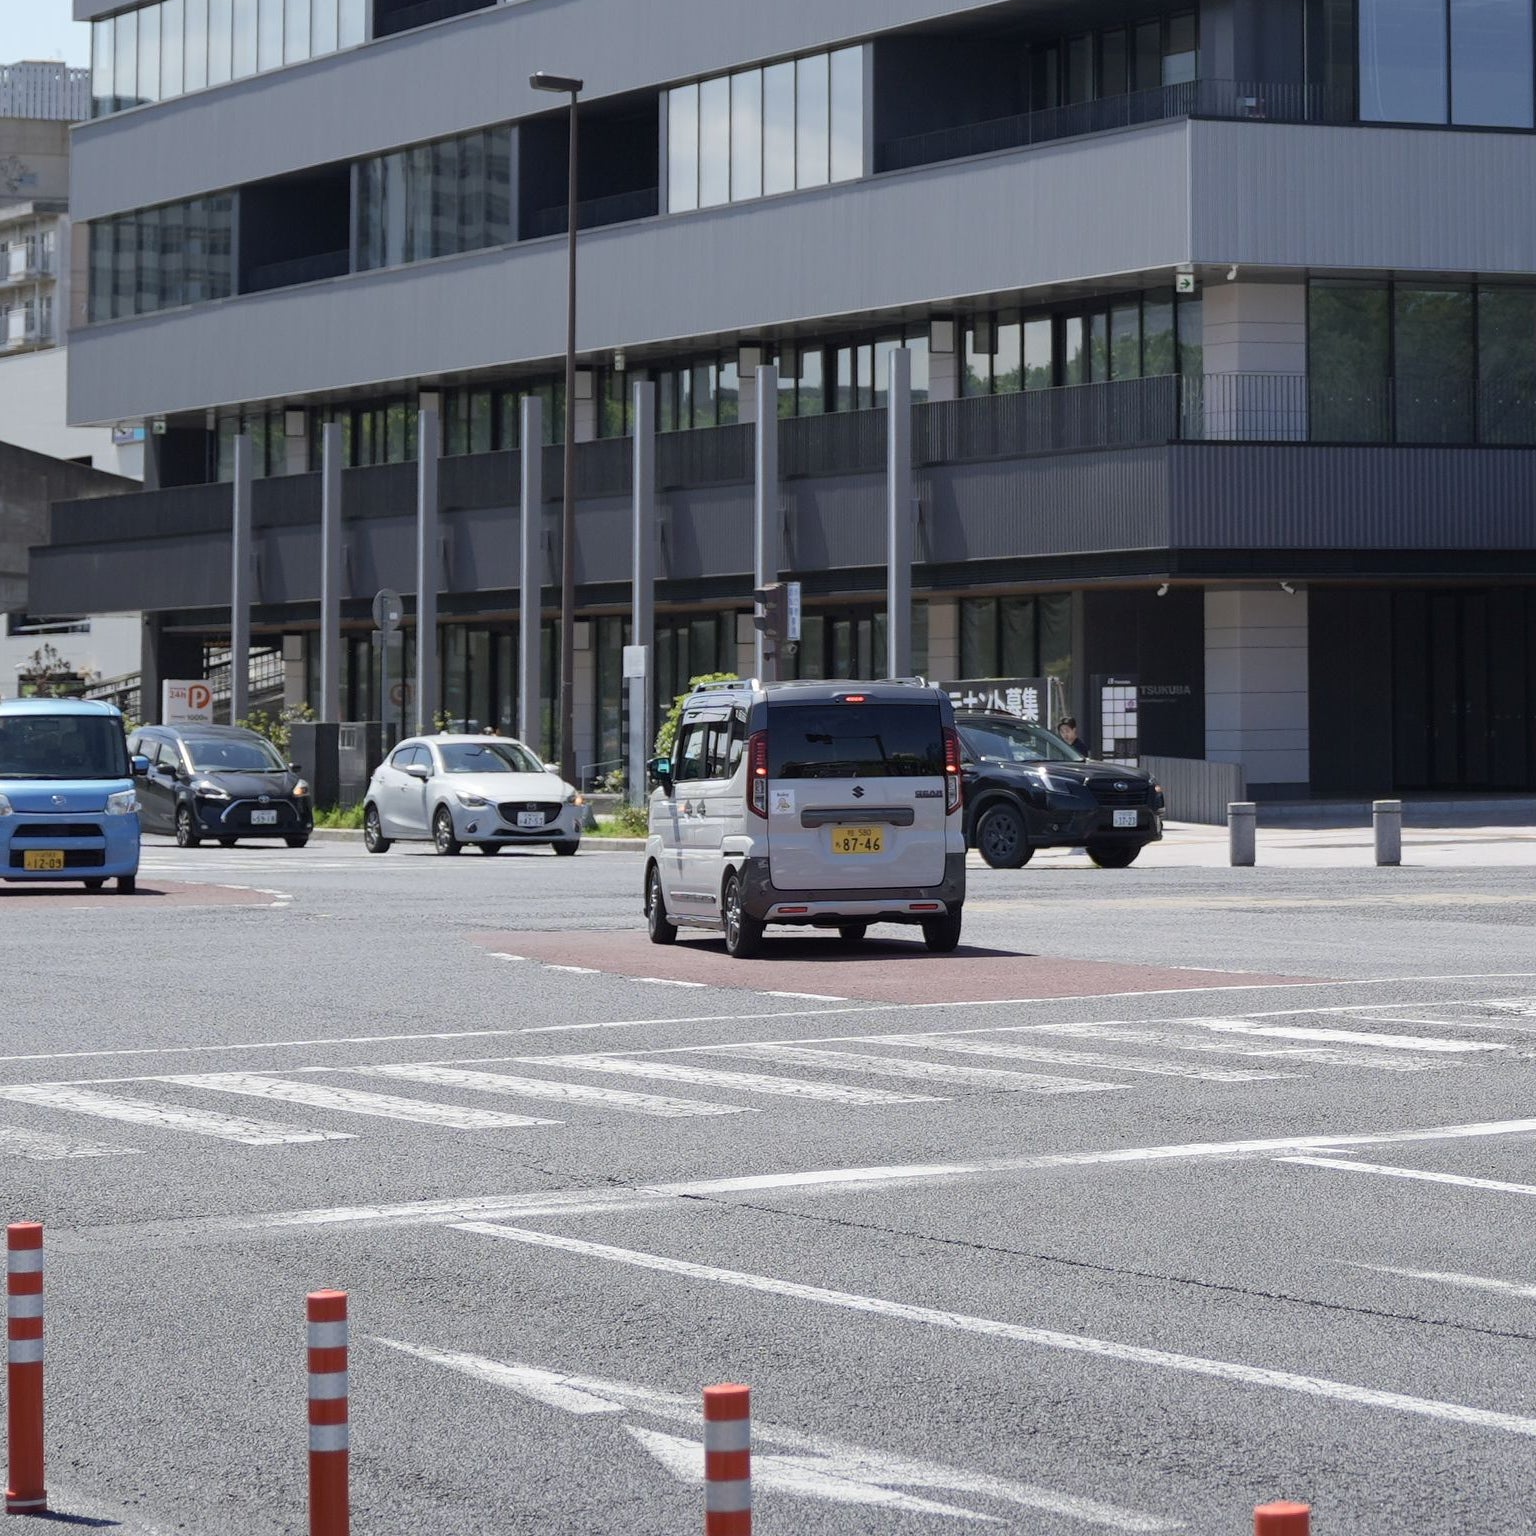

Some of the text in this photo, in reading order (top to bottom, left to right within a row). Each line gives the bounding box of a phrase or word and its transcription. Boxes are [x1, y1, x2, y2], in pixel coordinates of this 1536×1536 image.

[1140, 685, 1191, 695] TSUKUBA
[915, 790, 943, 798] GEAR
[843, 838, 880, 851] 87-46
